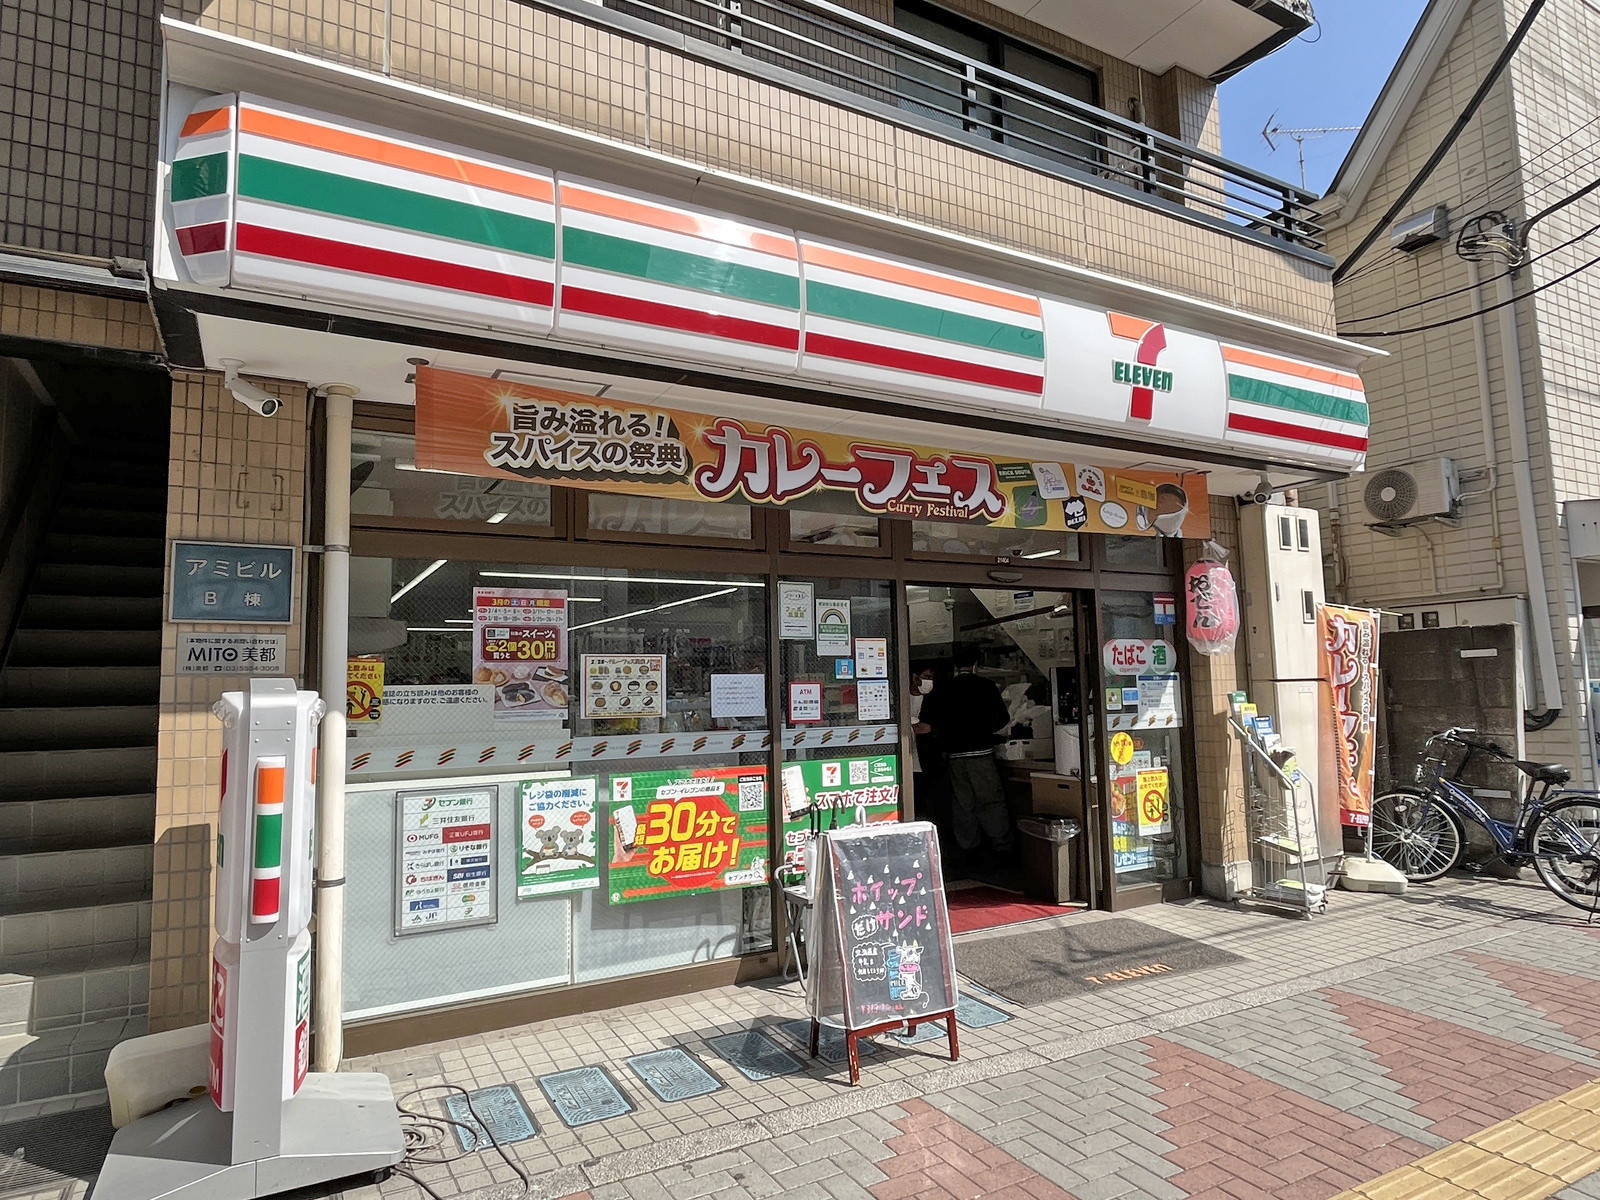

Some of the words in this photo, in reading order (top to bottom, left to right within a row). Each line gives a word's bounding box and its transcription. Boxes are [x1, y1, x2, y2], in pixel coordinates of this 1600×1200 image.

[490, 434, 682, 468] スパイスの祭典
[700, 424, 1001, 513] カレーフェス
[887, 499, 922, 517] Curry
[926, 501, 969, 518] Festival
[185, 559, 282, 579] アミビル
[204, 591, 217, 605] B
[243, 592, 262, 607] 棟
[187, 647, 238, 662] MITO
[242, 647, 276, 662] 美都
[517, 640, 556, 659] 30円
[1112, 645, 1147, 666] たばこ
[1152, 645, 1167, 666] 酒
[438, 798, 473, 807] セブン銀行
[529, 788, 587, 800] レジ袋の削減に
[817, 786, 899, 808] スマホで注文!
[529, 800, 590, 811] ご協力ください。
[432, 815, 475, 825] 三井住友銀行
[635, 823, 646, 845] 最短
[646, 802, 736, 845] 30分で
[419, 833, 439, 841] MUFG
[459, 843, 488, 852] りそな銀行
[650, 838, 740, 874] お届け!
[851, 872, 923, 904] ホイップ
[876, 905, 928, 931] サンド
